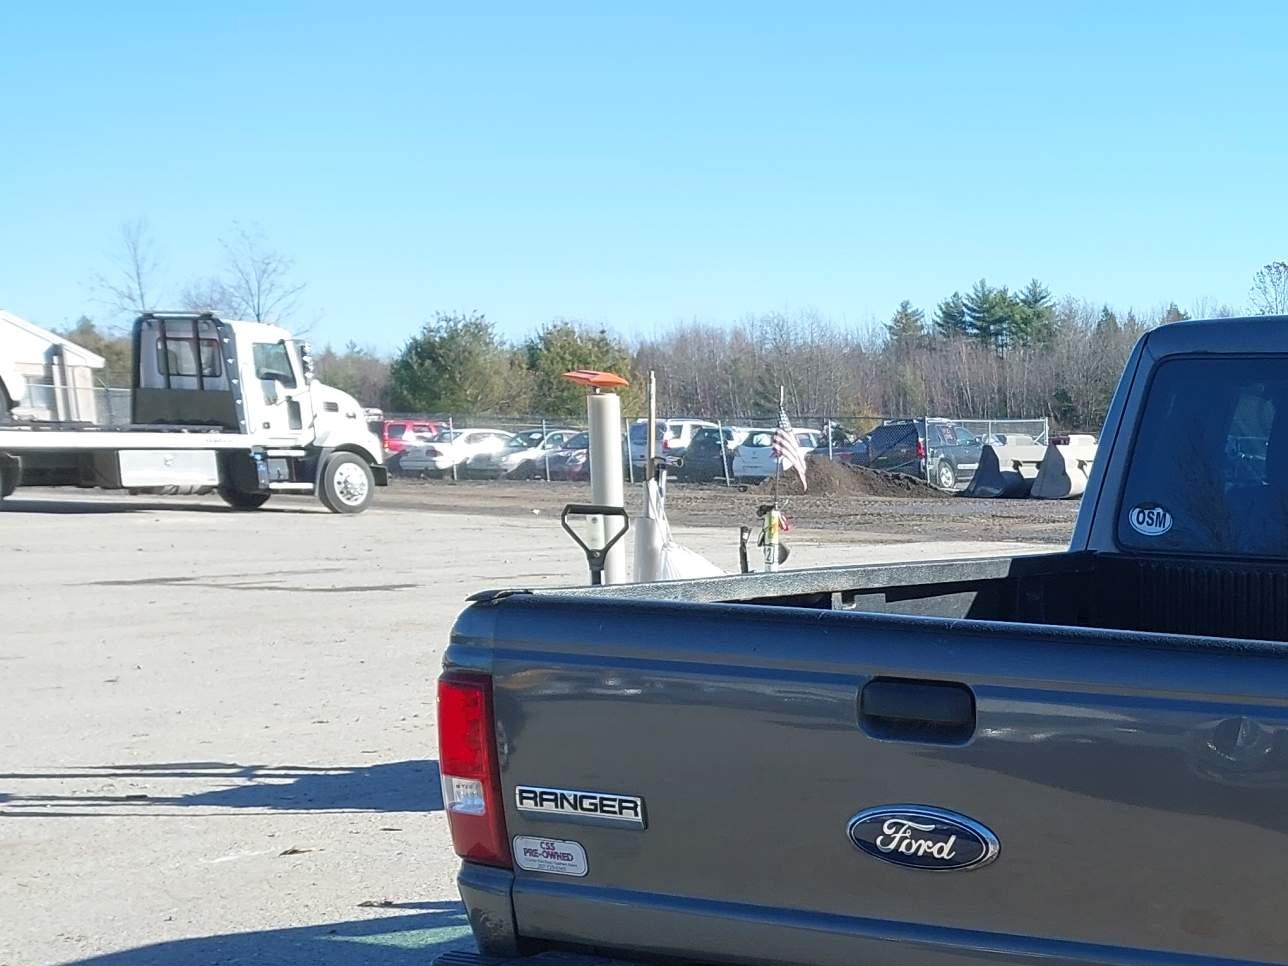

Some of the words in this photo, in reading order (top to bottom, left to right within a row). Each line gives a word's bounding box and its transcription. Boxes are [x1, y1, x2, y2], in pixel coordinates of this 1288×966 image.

[1136, 510, 1167, 528] OSM
[766, 547, 772, 562] 2
[518, 788, 639, 817] RANGER
[876, 818, 956, 860] Ford
[523, 847, 574, 862] PRE-OWNED
